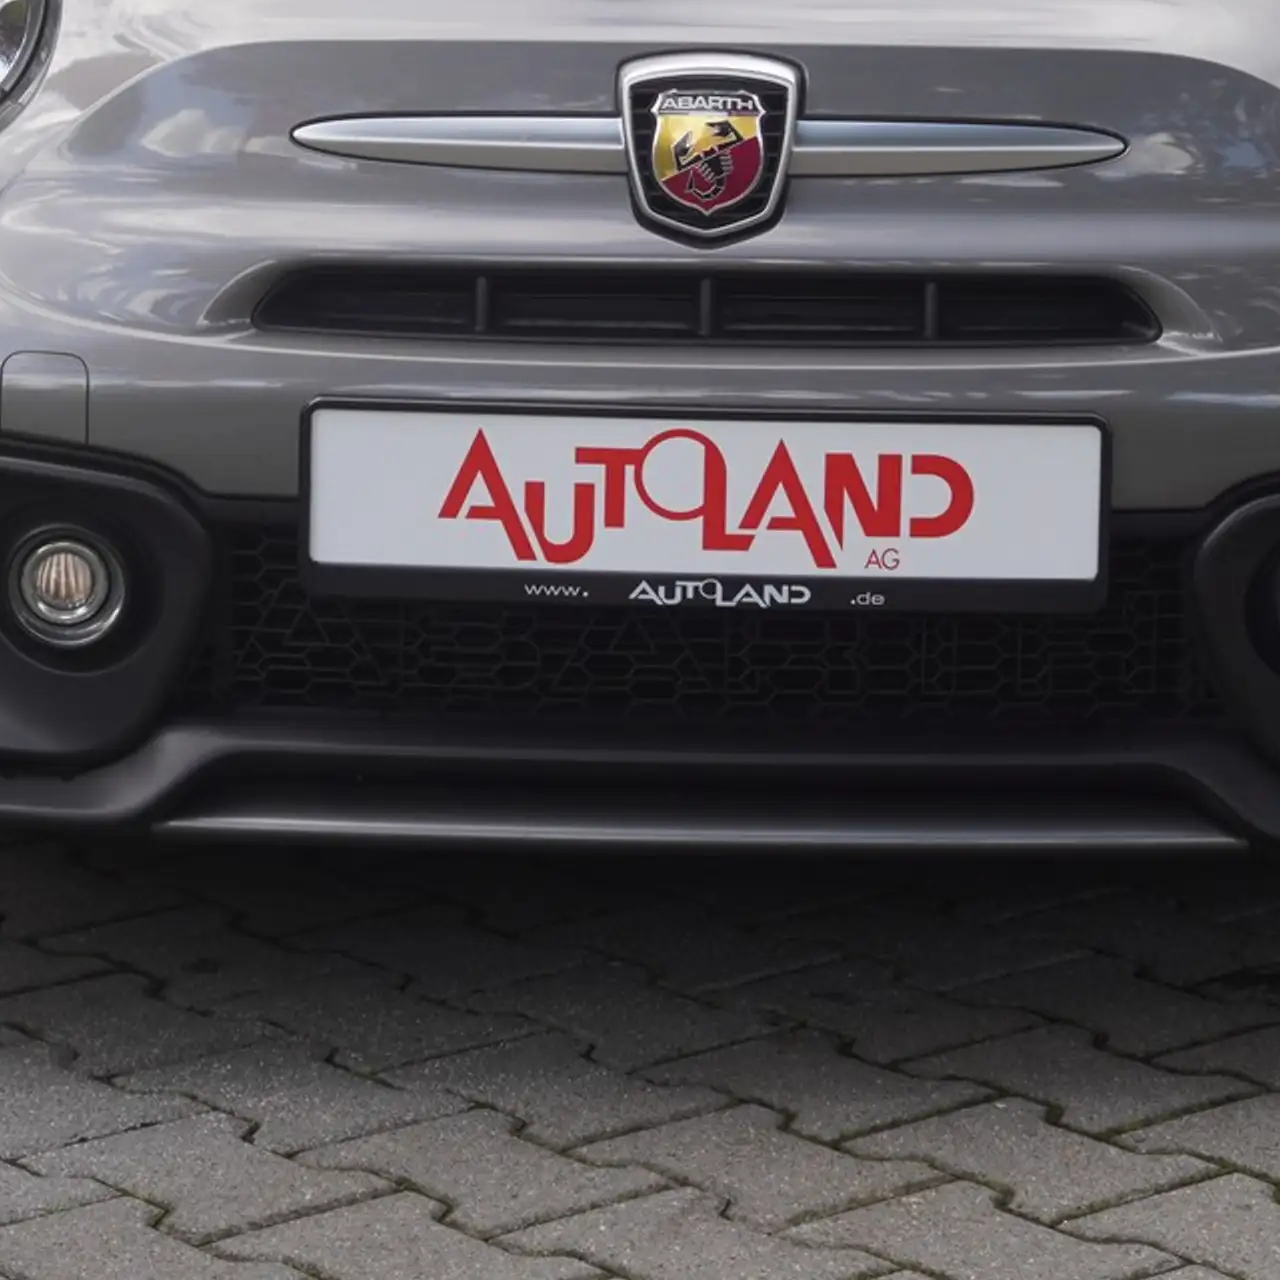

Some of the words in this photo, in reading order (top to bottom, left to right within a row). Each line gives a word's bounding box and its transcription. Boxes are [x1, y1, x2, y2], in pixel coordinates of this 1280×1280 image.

[662, 95, 754, 110] ABARTH
[864, 548, 901, 571] AG
[524, 583, 589, 598] www.
[850, 590, 885, 607] .de
